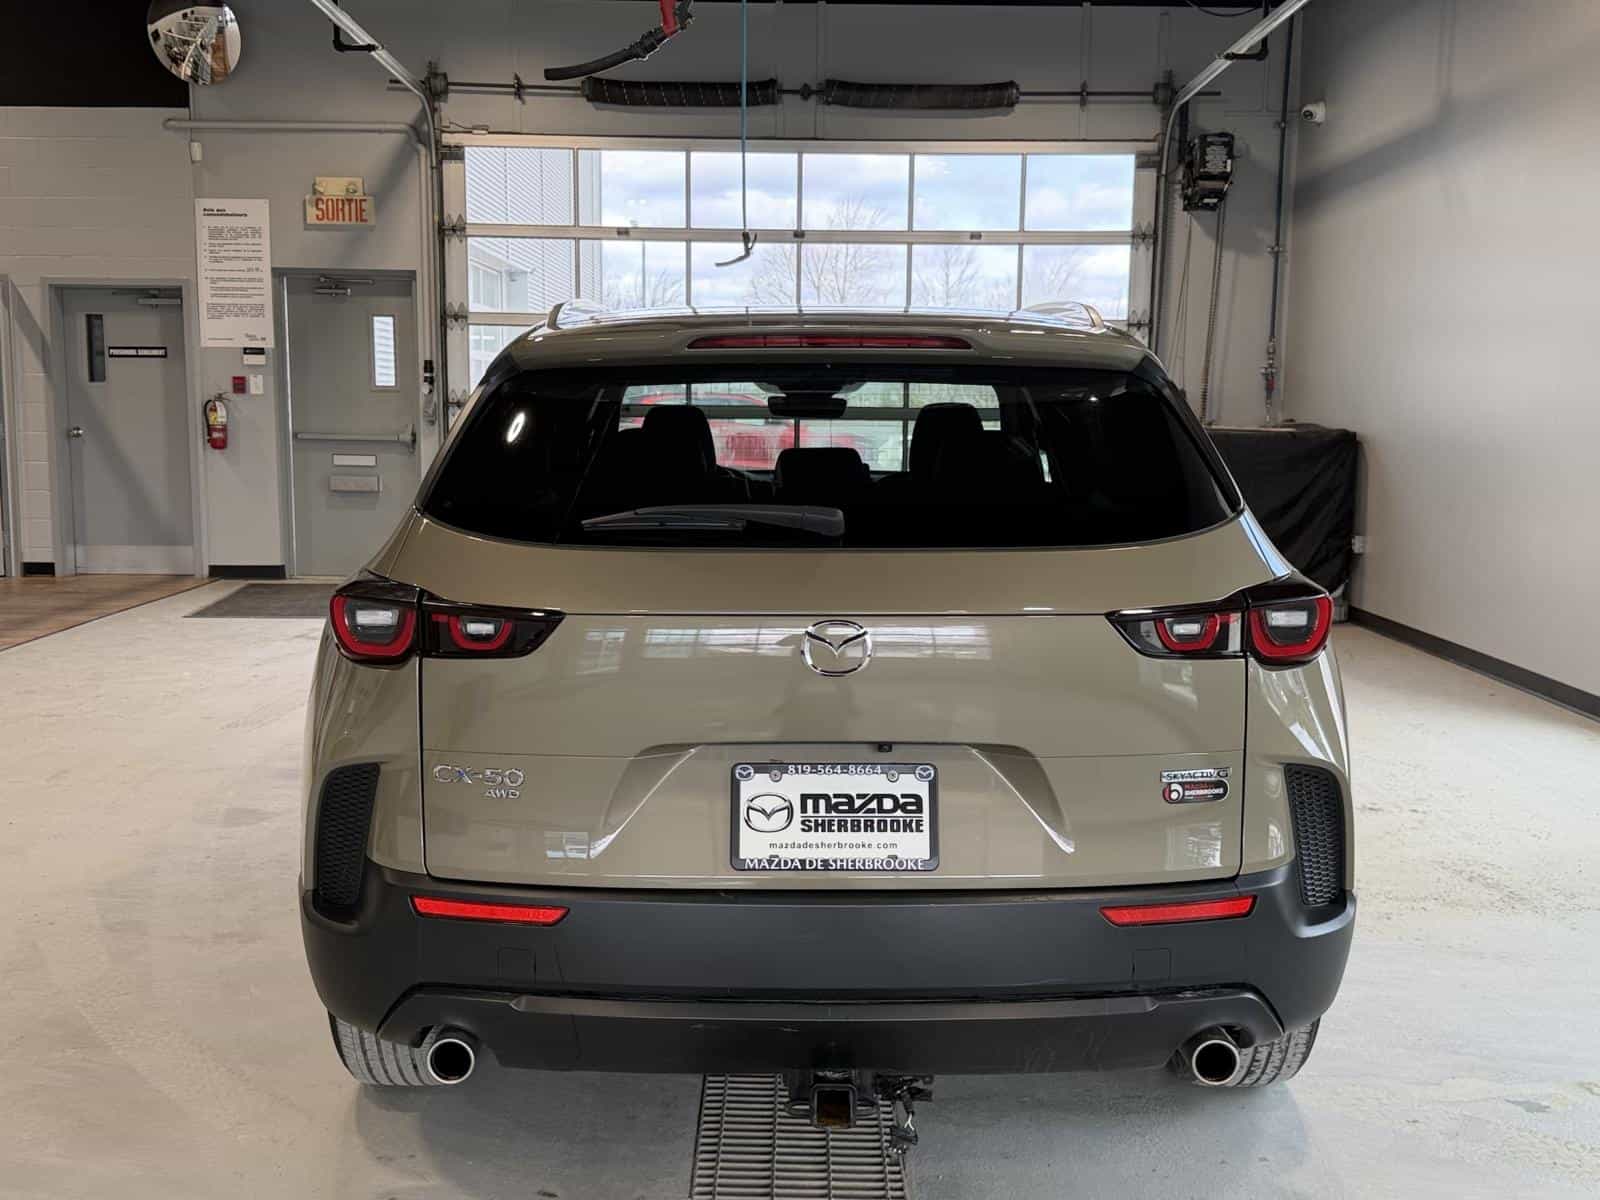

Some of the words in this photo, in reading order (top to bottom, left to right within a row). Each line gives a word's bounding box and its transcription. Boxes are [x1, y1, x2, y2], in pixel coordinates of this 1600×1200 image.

[315, 197, 368, 222] SORTIE
[434, 764, 525, 787] CX-50
[787, 765, 882, 776] 819-564-8664
[486, 787, 521, 799] AWD
[800, 818, 924, 833] SHERBROOKE
[769, 840, 898, 850] mazdadesherbrooke.com
[744, 857, 801, 870] MAZDA
[806, 858, 825, 870] DE
[829, 858, 924, 871] SHERBROOKE
